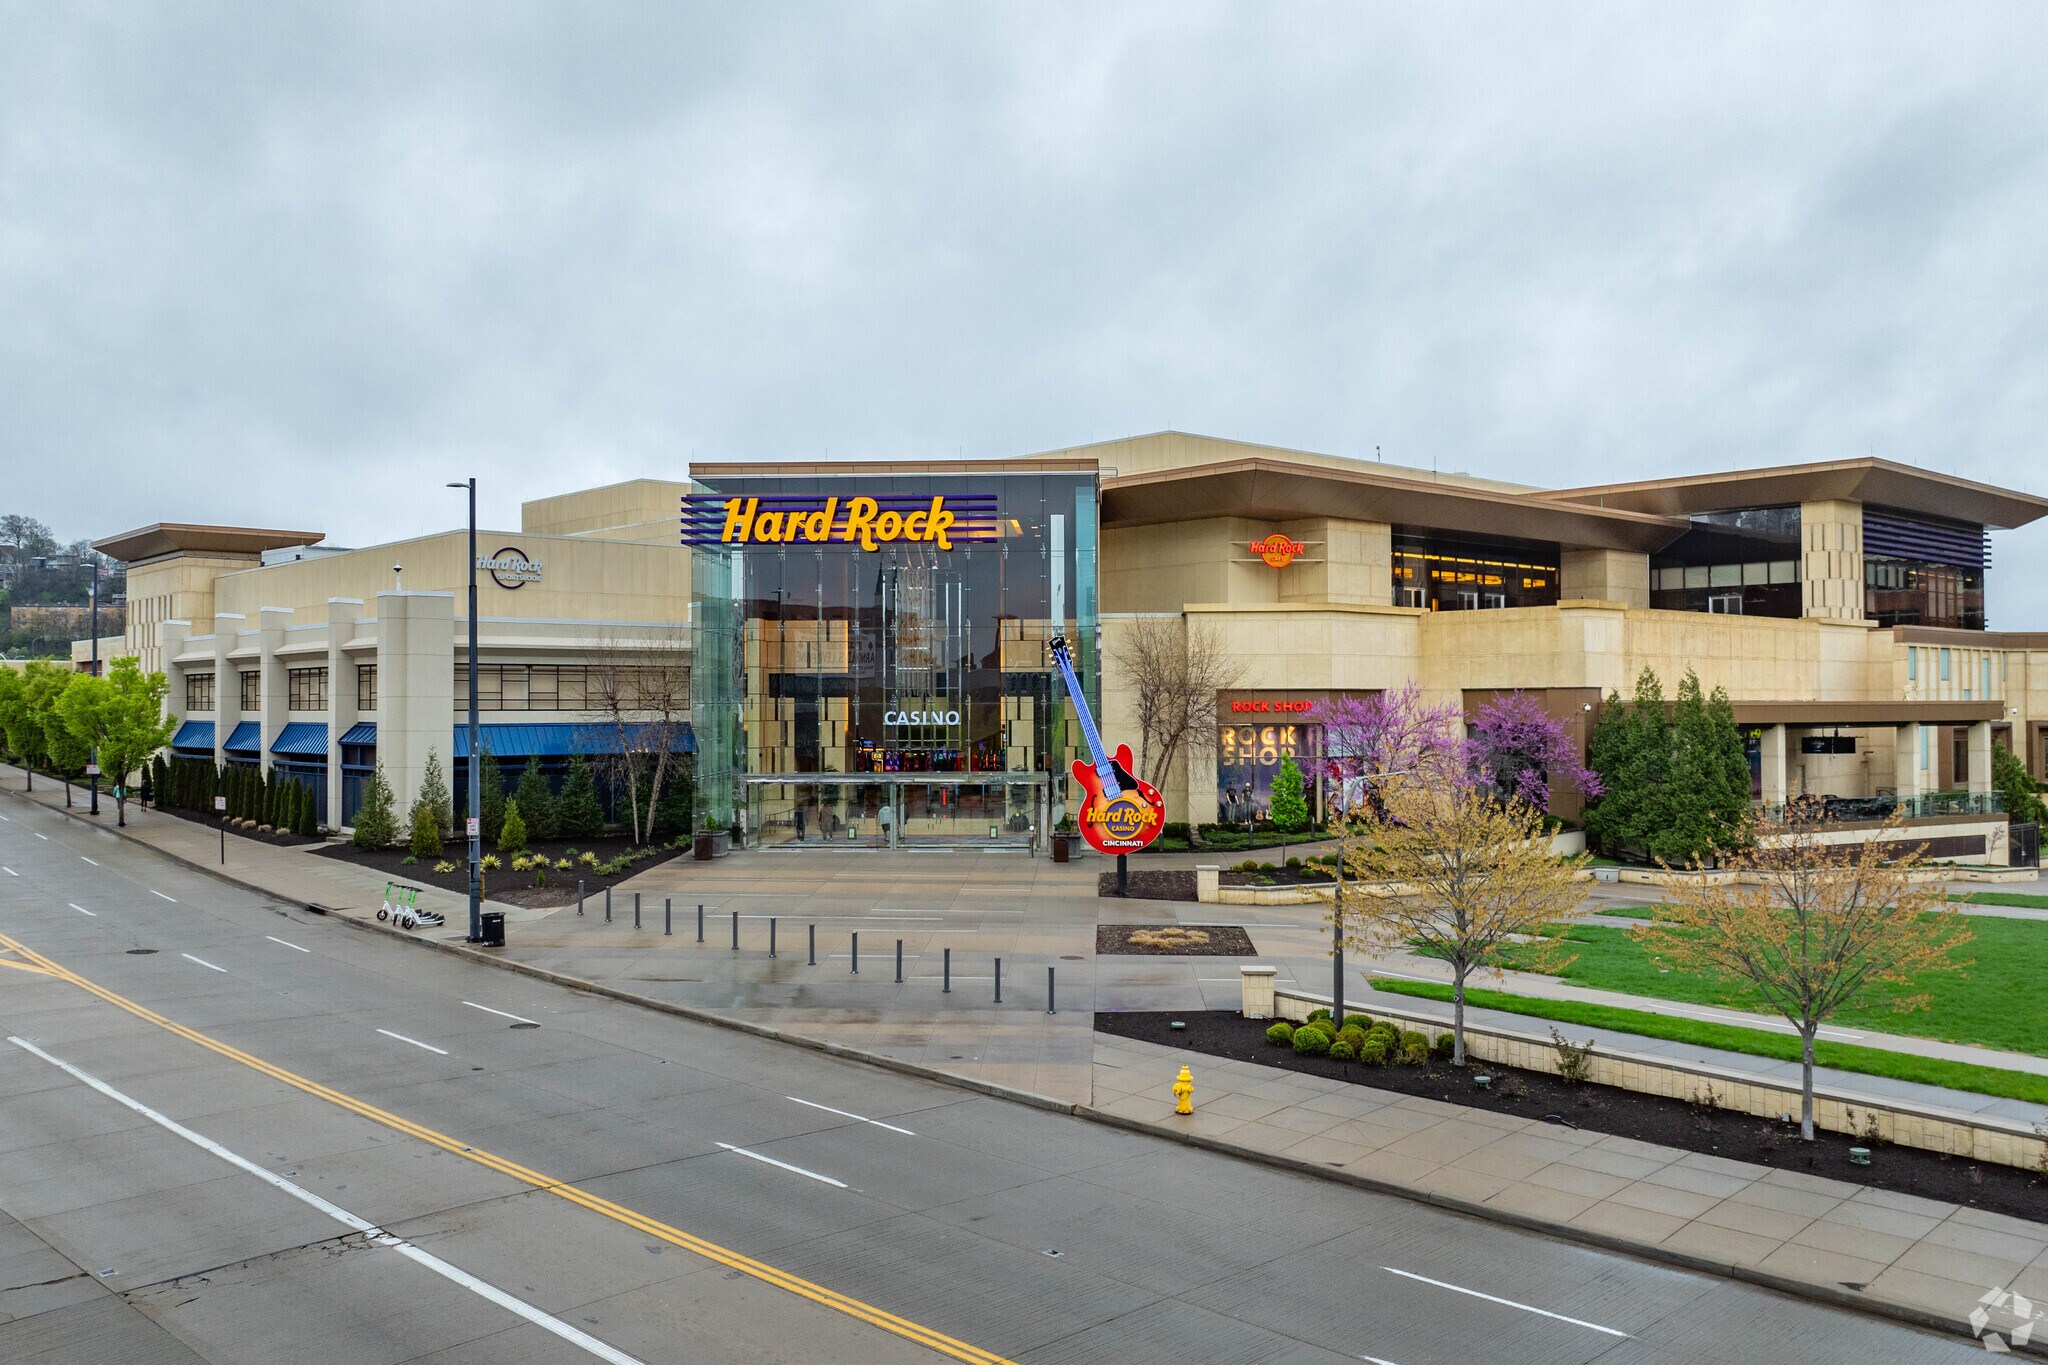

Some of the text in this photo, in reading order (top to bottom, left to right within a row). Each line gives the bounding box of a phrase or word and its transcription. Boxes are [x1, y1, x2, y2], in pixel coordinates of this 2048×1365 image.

[721, 495, 955, 552] Hard Rock
[1250, 541, 1304, 555] Hard Rock
[477, 554, 542, 575] Hard Rock
[498, 574, 541, 582] SPORTSBOOK
[1231, 700, 1313, 713] ROCK SHOP
[884, 711, 960, 726] CASINO
[1221, 726, 1297, 745] ROCK
[1222, 745, 1296, 766] SHOP
[1086, 807, 1158, 826] Hard Rock
